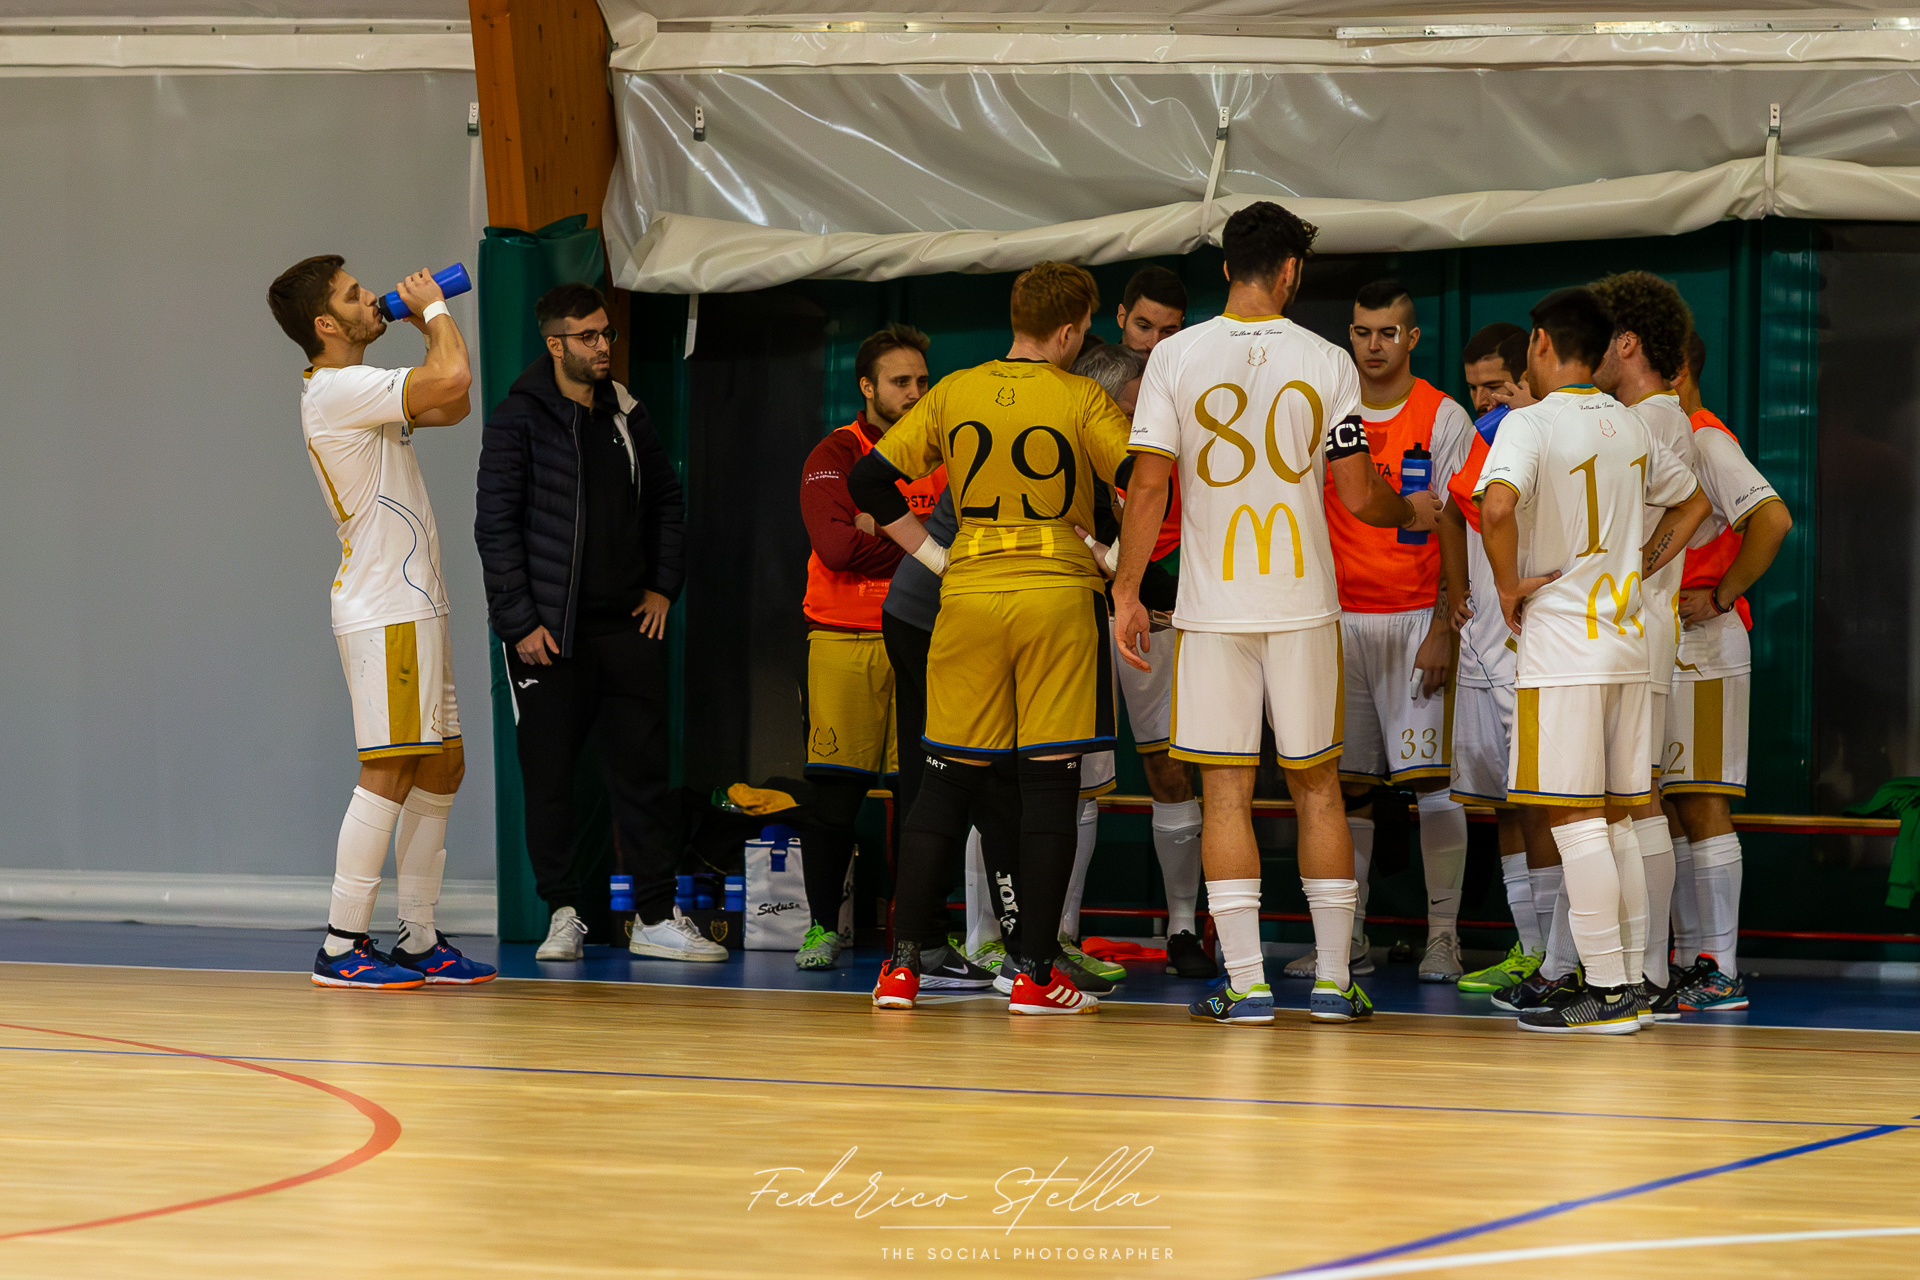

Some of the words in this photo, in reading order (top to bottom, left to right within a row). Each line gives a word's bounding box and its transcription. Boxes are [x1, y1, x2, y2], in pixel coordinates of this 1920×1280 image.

[1194, 380, 1323, 488] 80
[1335, 422, 1358, 448] C
[948, 420, 1077, 521] 29
[1400, 727, 1438, 760] 33
[1660, 741, 1686, 776] 2
[756, 902, 795, 917] Sixtus
